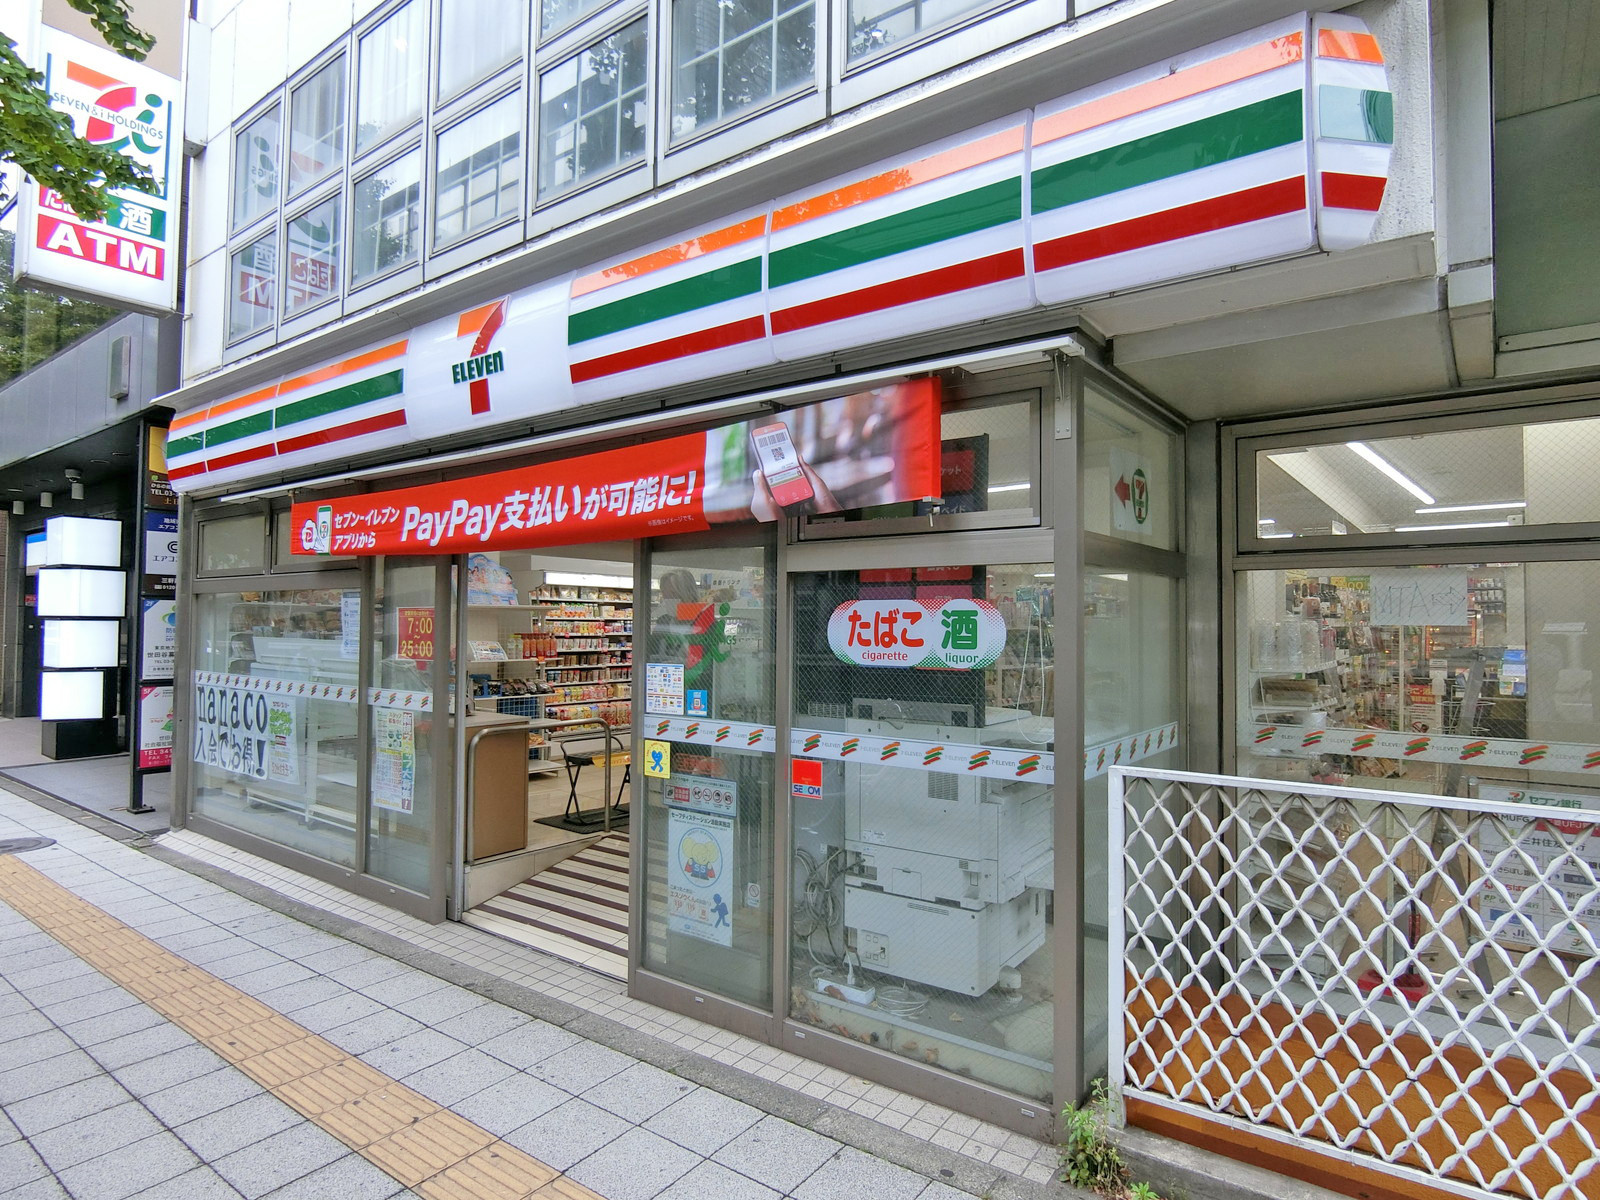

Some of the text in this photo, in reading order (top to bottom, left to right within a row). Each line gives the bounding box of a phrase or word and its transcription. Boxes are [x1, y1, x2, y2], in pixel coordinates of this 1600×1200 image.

[53, 92, 90, 114] SEVEN
[107, 112, 164, 140] HOLDINGS
[119, 202, 154, 236] 酒
[46, 222, 157, 276] ATM
[334, 532, 377, 551] アプリから
[407, 617, 433, 634] 7:00
[848, 608, 925, 649] たばこ
[941, 609, 979, 650] 酒
[401, 640, 433, 658] 25:00
[861, 650, 908, 663] cigarette
[945, 652, 979, 665] liquor
[197, 685, 268, 735] nanaco
[194, 727, 267, 778] 入会でお得!
